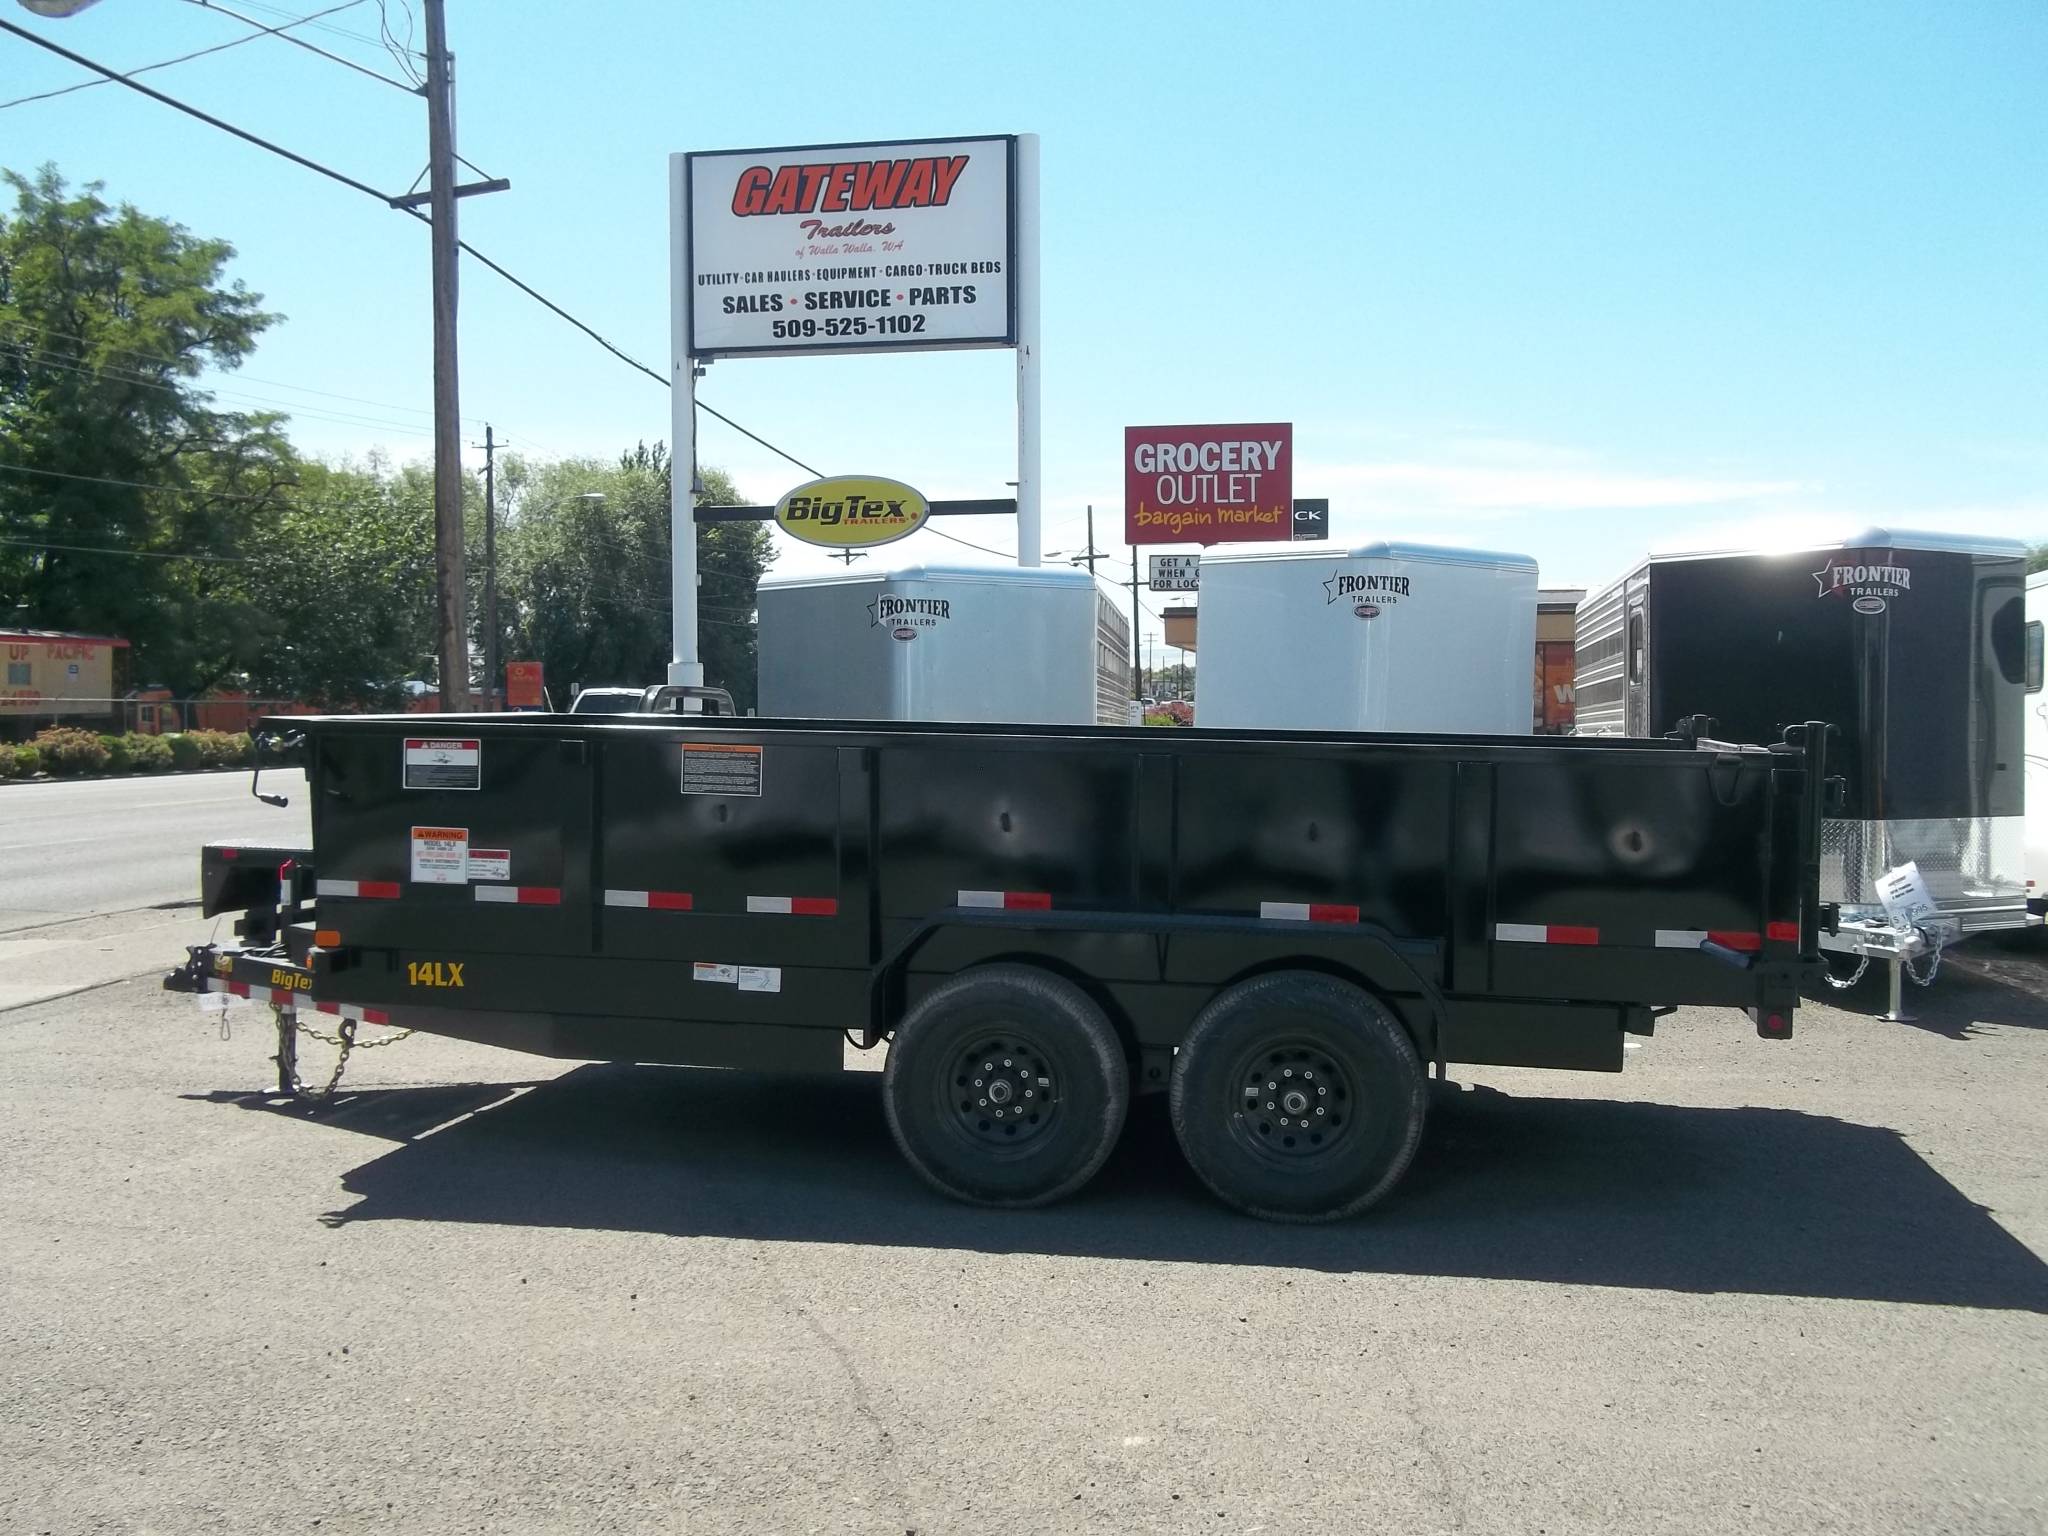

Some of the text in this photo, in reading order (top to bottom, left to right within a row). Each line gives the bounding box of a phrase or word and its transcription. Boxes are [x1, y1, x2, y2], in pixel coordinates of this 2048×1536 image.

[731, 156, 970, 217] GATEWAY
[800, 219, 896, 240] Trailers
[795, 246, 805, 259] of
[808, 244, 838, 256] Walla
[881, 240, 904, 252] WA
[698, 261, 1001, 286] UTILITY CAR HAULERS EQUIPMENT CARGO TRUCK BEDS
[722, 285, 977, 315] SALES SERVICE PARTS
[772, 314, 926, 339] 509-525-1102
[1134, 440, 1282, 473] GROCERY
[1156, 473, 1262, 505] OUTLET
[843, 516, 906, 526] TRAILERS
[1134, 501, 1283, 535] bargain market
[1160, 558, 1191, 567] GET A
[1153, 579, 1172, 589] FOR
[1158, 569, 1186, 578] WHEN
[1832, 565, 1911, 590] FRONTIER
[1338, 575, 1410, 597] FRONTIER
[1850, 587, 1899, 597] TRAILERS
[880, 598, 950, 619] FRONTIER
[1352, 595, 1397, 604] TRAILERS
[890, 618, 937, 626] TRAILERS
[430, 741, 463, 750] DANGER
[424, 831, 463, 840] WARNING
[407, 962, 465, 987] 14LX
